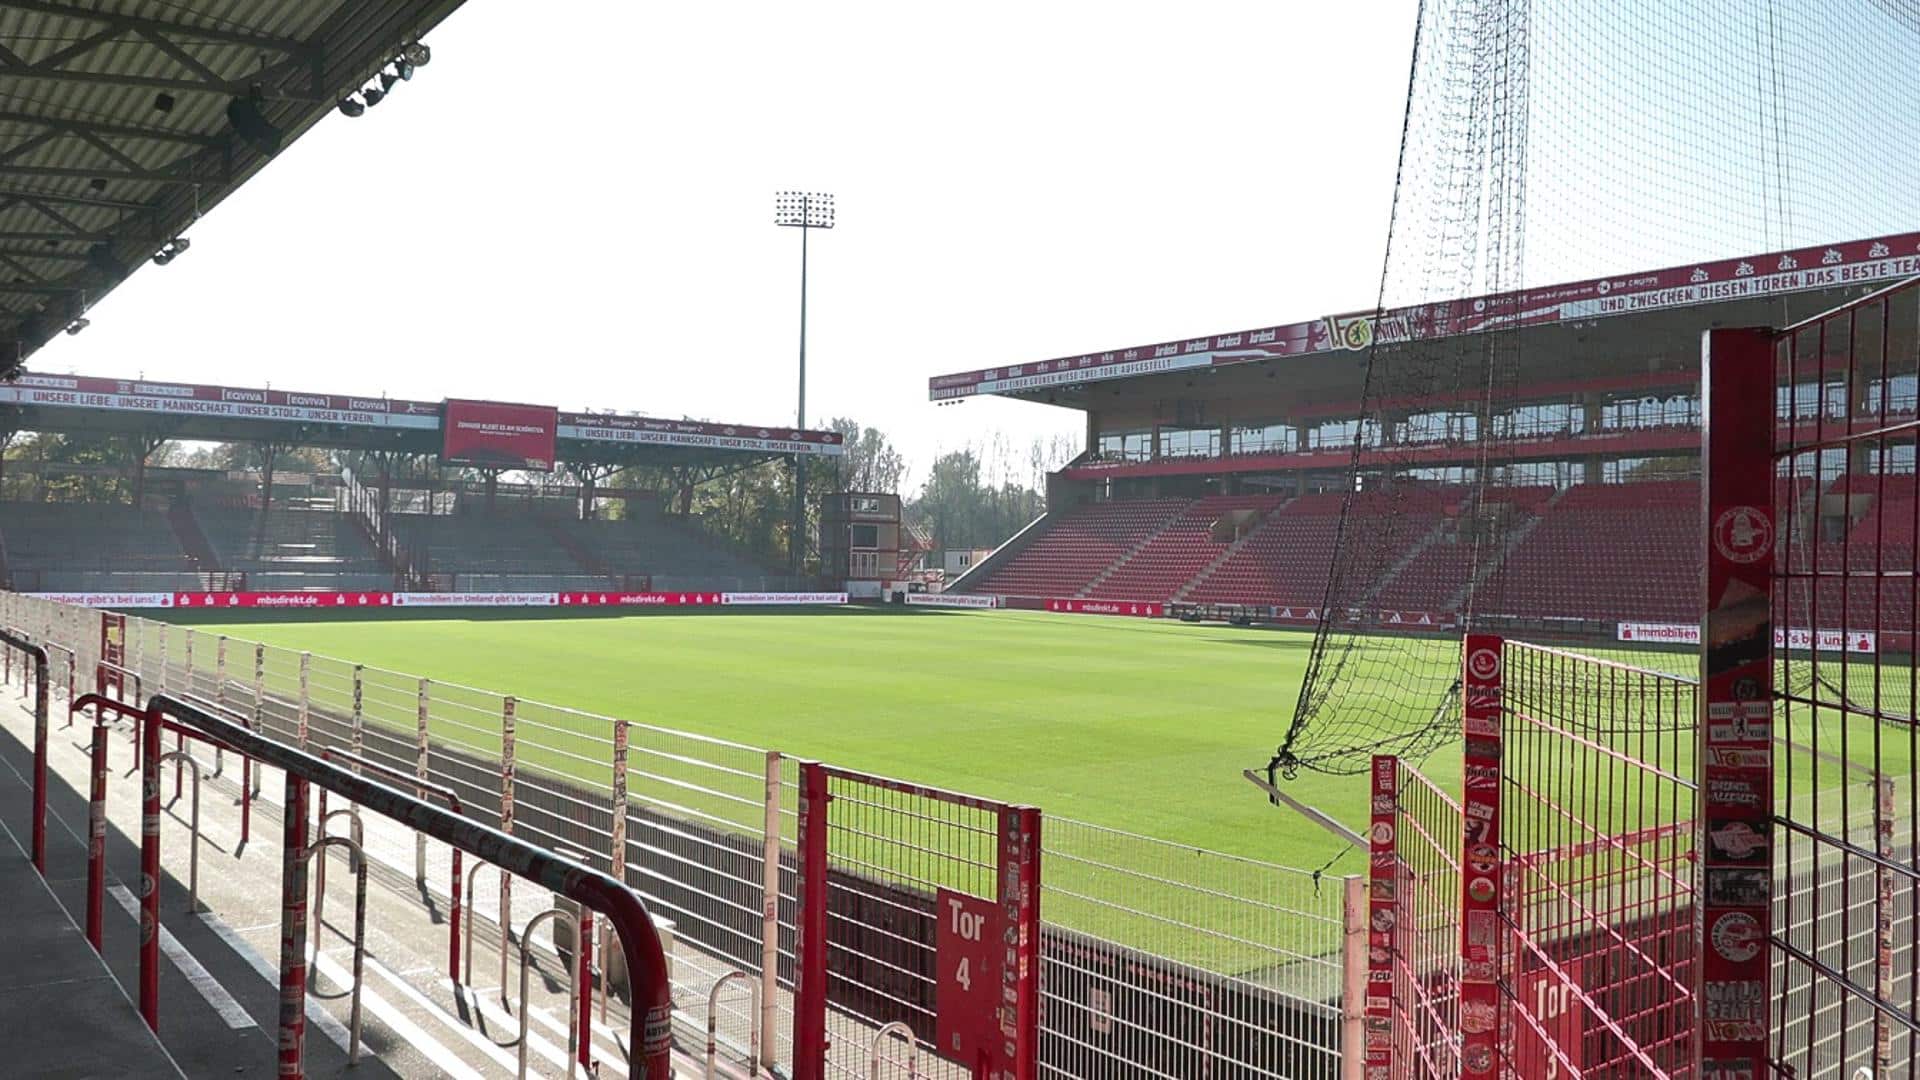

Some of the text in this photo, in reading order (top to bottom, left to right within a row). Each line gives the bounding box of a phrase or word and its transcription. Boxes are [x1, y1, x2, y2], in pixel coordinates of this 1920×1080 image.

[1600, 300, 1625, 312] UND
[1630, 288, 1693, 309] ZWISCHEN
[1700, 282, 1748, 299] DIESEN
[1754, 276, 1798, 292] TOREN
[1806, 270, 1834, 286] DAS
[1841, 262, 1887, 281] BESTE
[33, 391, 76, 404] UNSERE
[118, 395, 160, 409] UNSERE
[239, 404, 270, 416] UNSER
[308, 410, 338, 421] UNSER
[87, 594, 115, 607] gibt's
[119, 594, 133, 604] bei
[257, 596, 318, 606] mbsdirekt.de
[465, 595, 493, 604] Umland
[1637, 626, 1698, 640] Immobilien
[1802, 632, 1820, 645] bi
[1824, 634, 1851, 647] un!
[948, 898, 985, 942] Tor
[956, 956, 970, 992] 4
[1533, 979, 1570, 1021] Tor
